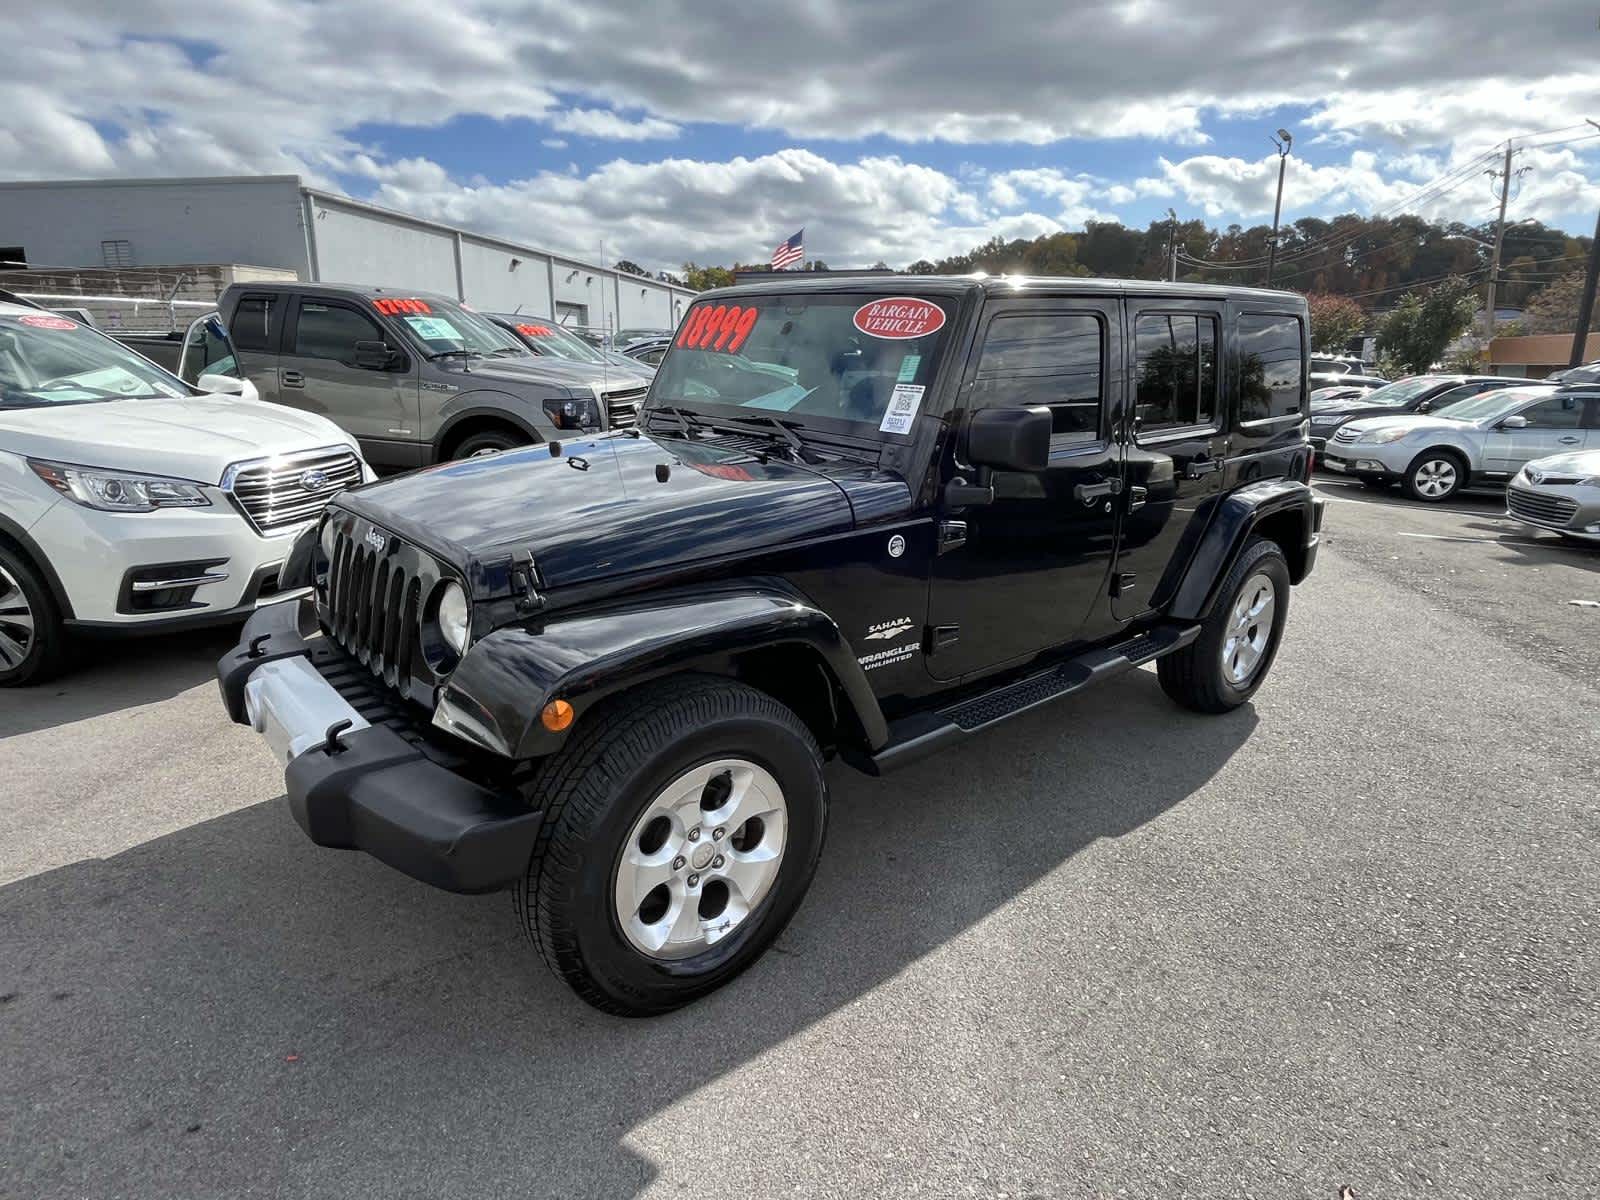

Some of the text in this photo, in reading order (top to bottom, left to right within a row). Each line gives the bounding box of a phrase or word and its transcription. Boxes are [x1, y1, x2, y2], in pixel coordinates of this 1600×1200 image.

[868, 304, 933, 319] BARGAIN
[676, 304, 757, 353] 18999
[865, 317, 927, 333] VEHICLE
[366, 527, 385, 552] Jeep
[868, 616, 911, 633] SAHARA
[858, 642, 920, 664] WRANGLER
[864, 653, 912, 670] UNLIMITED
